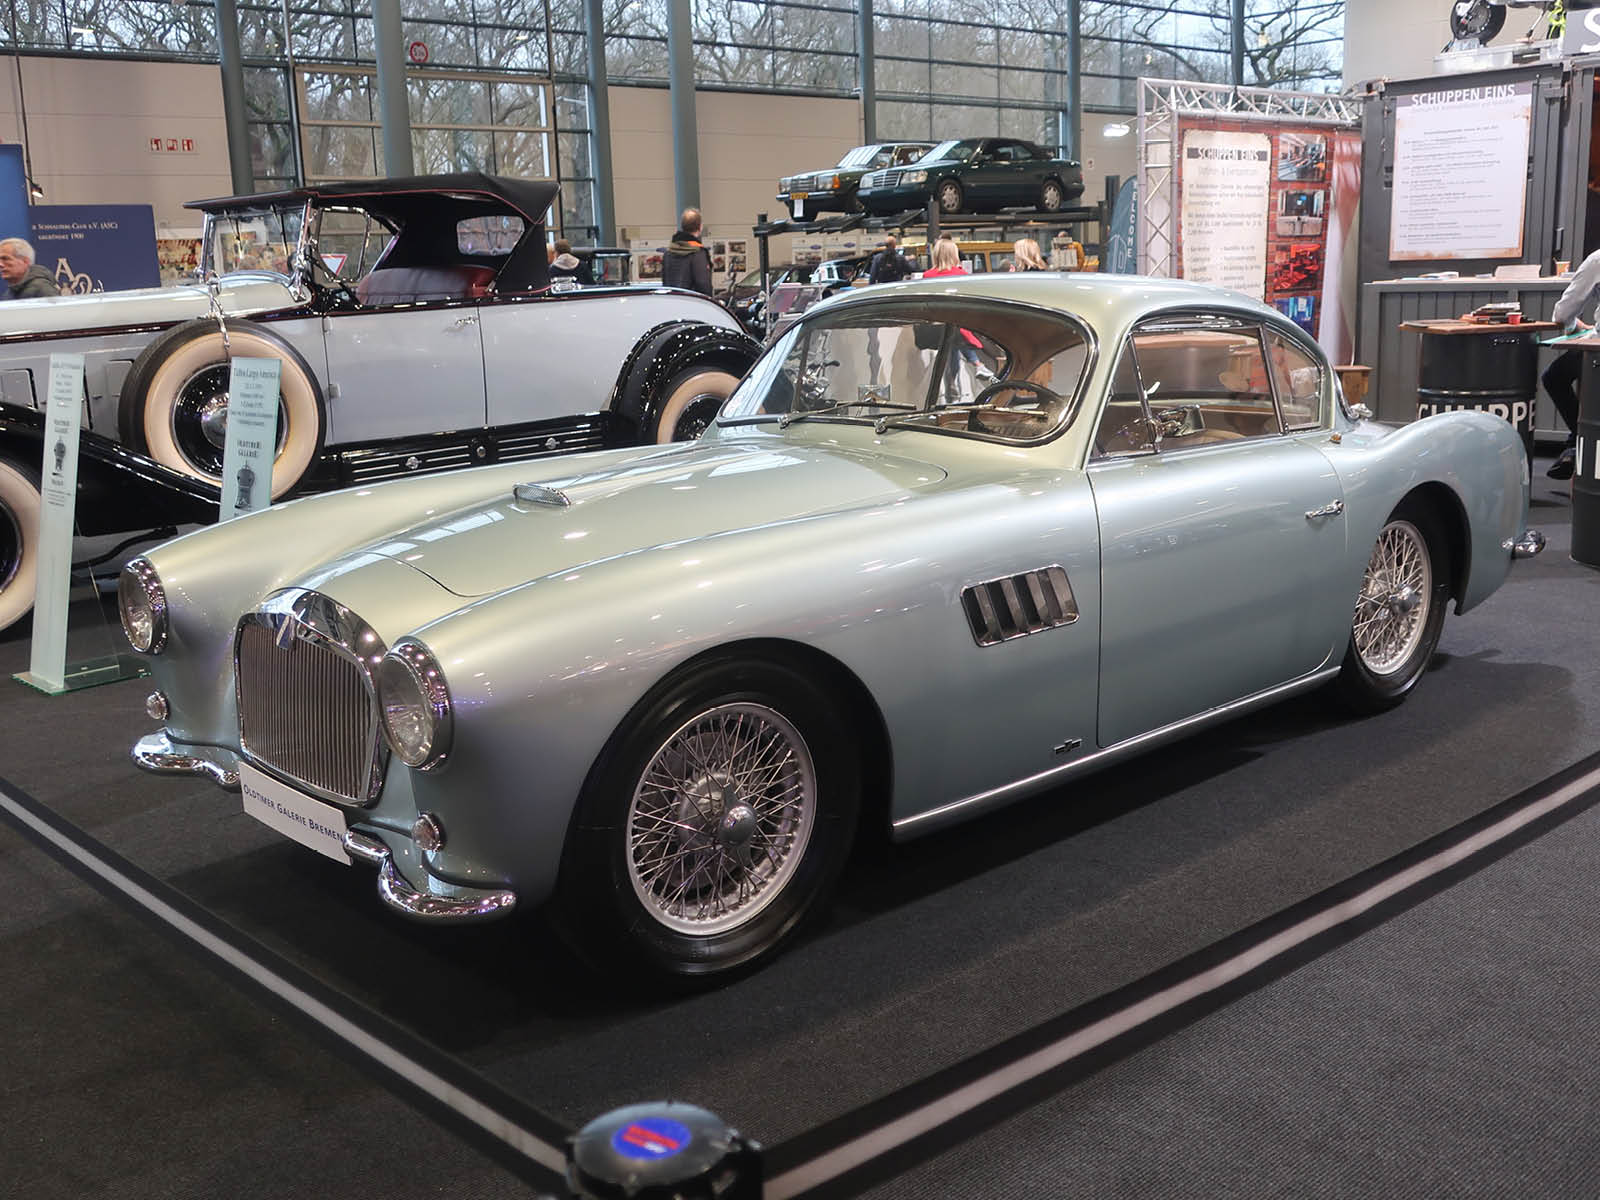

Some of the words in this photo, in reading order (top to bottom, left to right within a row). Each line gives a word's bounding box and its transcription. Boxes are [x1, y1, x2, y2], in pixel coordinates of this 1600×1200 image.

[1412, 88, 1480, 106] SCHUPPEN
[1485, 84, 1515, 99] EINS
[1200, 147, 1238, 161] SCHUPPEN
[1241, 149, 1259, 161] EINS
[243, 784, 275, 810] OLDTIMER
[277, 803, 307, 826] GALERIE
[309, 818, 344, 842] BREMEN
